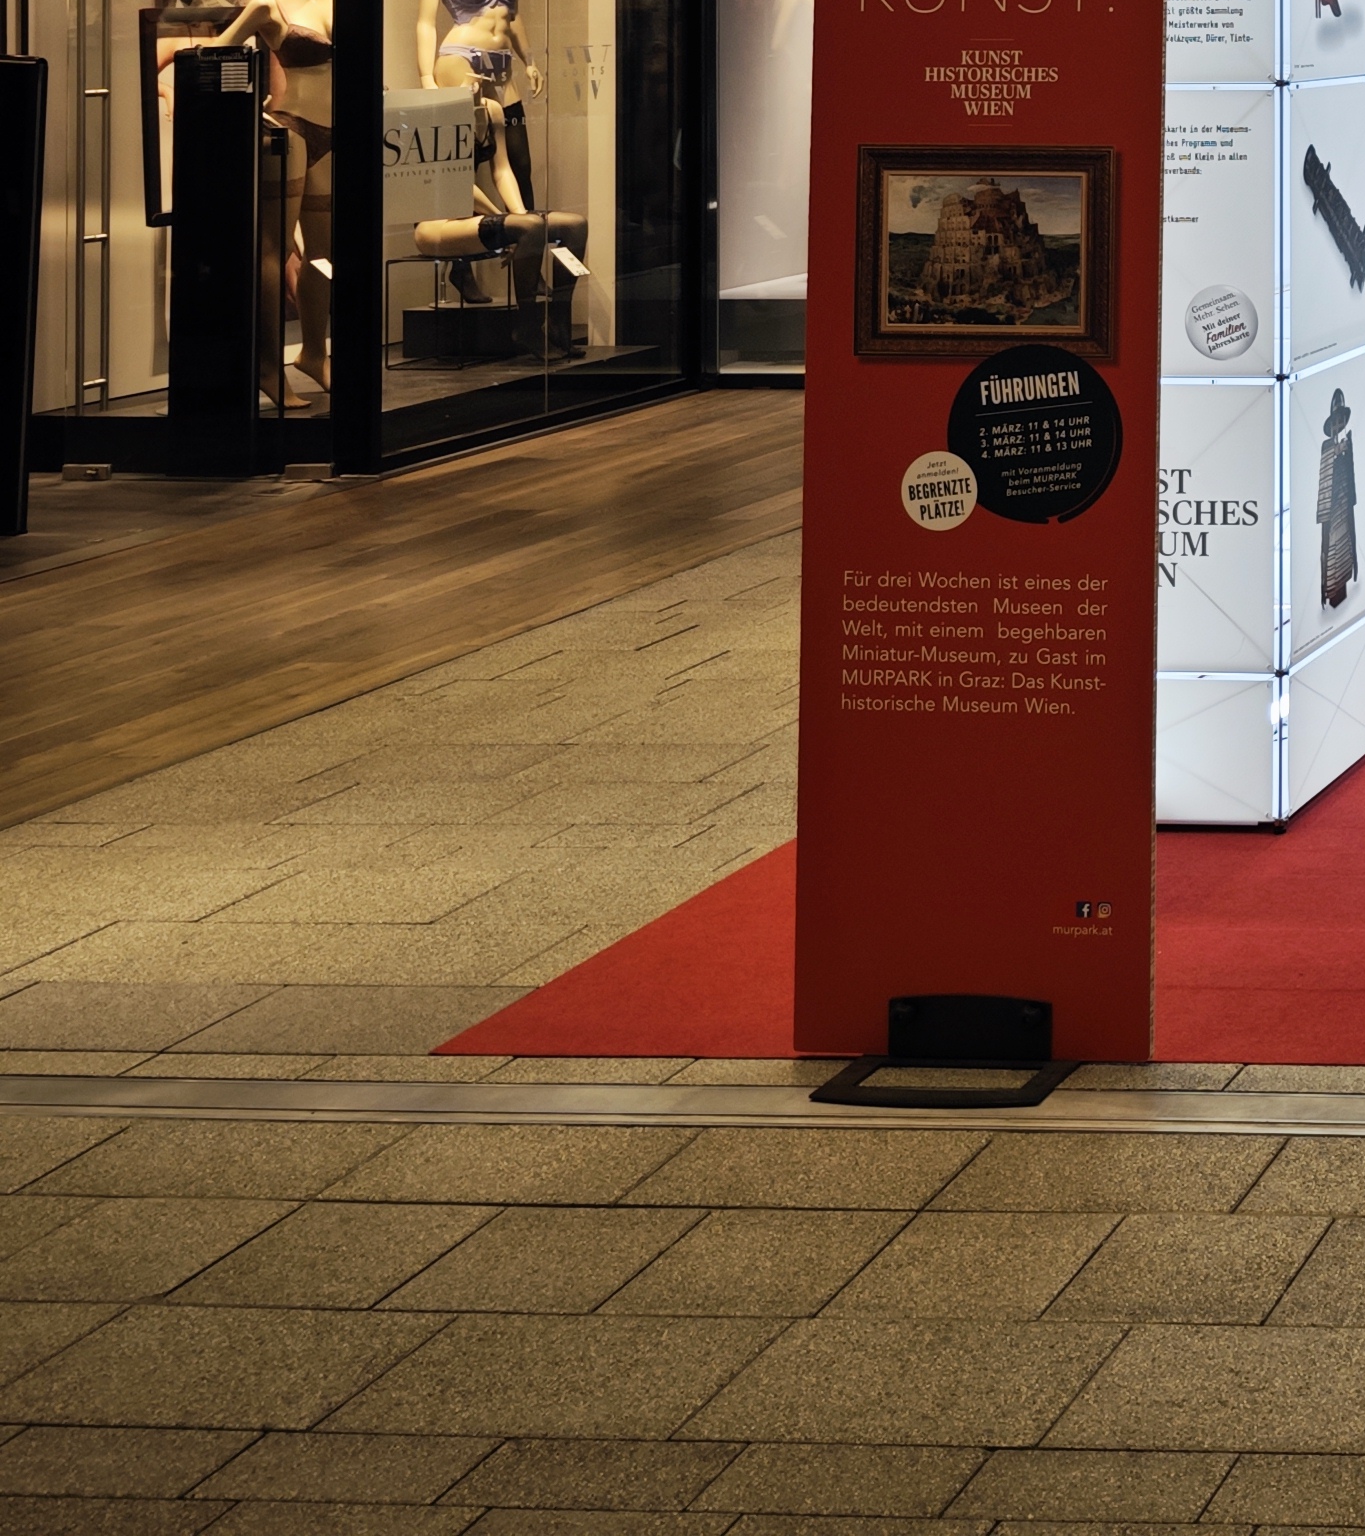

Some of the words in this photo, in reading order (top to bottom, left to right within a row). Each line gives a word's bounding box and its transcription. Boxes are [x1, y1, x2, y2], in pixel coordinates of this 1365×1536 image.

[962, 50, 1023, 65] KUNST
[925, 67, 1058, 82] HISTORISCHES
[951, 84, 1031, 99] MUSEUM
[964, 101, 1014, 116] WIEN
[383, 124, 472, 167] SALE
[1202, 323, 1216, 332] Mit
[1218, 313, 1240, 326] deiner
[1206, 322, 1246, 344] Familien
[1208, 332, 1249, 353] Jahreskarte
[980, 371, 1080, 405] FÜHRUNGEN
[980, 428, 988, 436] 2.
[992, 424, 1024, 436] MÄRZ:
[1029, 422, 1038, 430] 11
[1042, 420, 1049, 429] &
[1054, 419, 1064, 427] 14
[1069, 416, 1089, 426] UHR
[981, 439, 989, 448] 3.
[993, 435, 1025, 446] MÄRZ:
[1030, 433, 1039, 442] 11
[1044, 432, 1050, 440] &
[1056, 430, 1066, 438] 14
[1070, 427, 1090, 437] UHR
[994, 446, 1026, 457] MÄRZ:
[1031, 445, 1040, 453] 11
[1045, 444, 1052, 452] &
[1057, 442, 1067, 450] 13
[1071, 439, 1092, 449] UHR
[917, 468, 958, 479] anmelden!
[927, 461, 946, 469] Jetzt
[1018, 463, 1082, 475] Voranmeldung
[1009, 478, 1030, 486] beim
[1033, 469, 1077, 483] MURPARK
[908, 478, 972, 501] BEGRENZTE
[1006, 483, 1081, 496] Besucher-Service
[920, 500, 965, 520] PLÄTZE!
[844, 570, 872, 586] Für
[878, 570, 911, 587] drei
[918, 572, 990, 588] Wochen
[999, 574, 1018, 589] ist
[1025, 574, 1071, 590] eines
[1078, 574, 1108, 591] der
[843, 594, 978, 613] bedeutendsten
[994, 598, 1062, 614] Museen
[1078, 599, 1108, 616] der
[842, 620, 887, 638] Welt,
[896, 621, 923, 637] mit
[930, 622, 983, 638] einem
[998, 622, 1106, 644] begehbaren
[843, 644, 1000, 666] Miniatur-Museum,
[1009, 652, 1028, 664] zu
[1036, 648, 1077, 665] Gast
[1086, 650, 1105, 665] im
[843, 669, 932, 686] MURPARK
[939, 671, 952, 686] in
[959, 671, 1004, 688] Graz:
[1012, 672, 1044, 689] Das
[1051, 674, 1106, 690] Kunst-
[842, 693, 935, 711] historische
[943, 696, 1017, 713] Museum
[1024, 698, 1075, 714] Wien.
[1053, 924, 1112, 938] murpark.at
